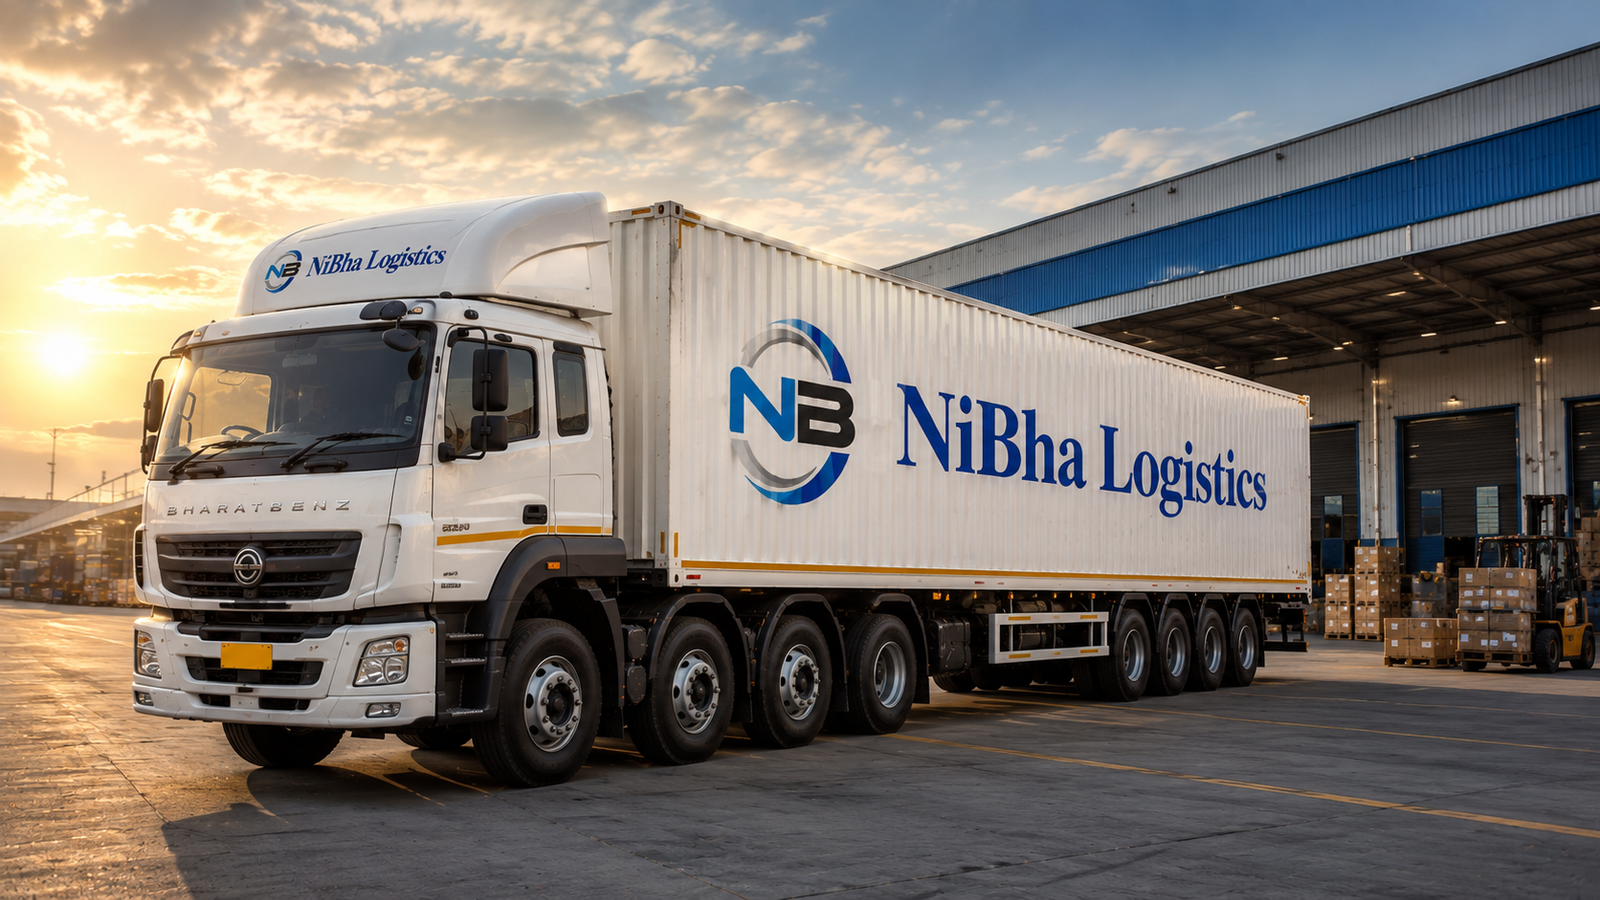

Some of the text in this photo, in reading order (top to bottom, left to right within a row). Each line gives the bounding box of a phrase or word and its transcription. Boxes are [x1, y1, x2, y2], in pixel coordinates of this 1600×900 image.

[265, 262, 301, 280] NB
[305, 245, 446, 277] NiBha Logistics
[729, 366, 855, 448] NB
[896, 382, 1267, 518] NiBha Logistics
[167, 499, 350, 516] BHARATBENZ
